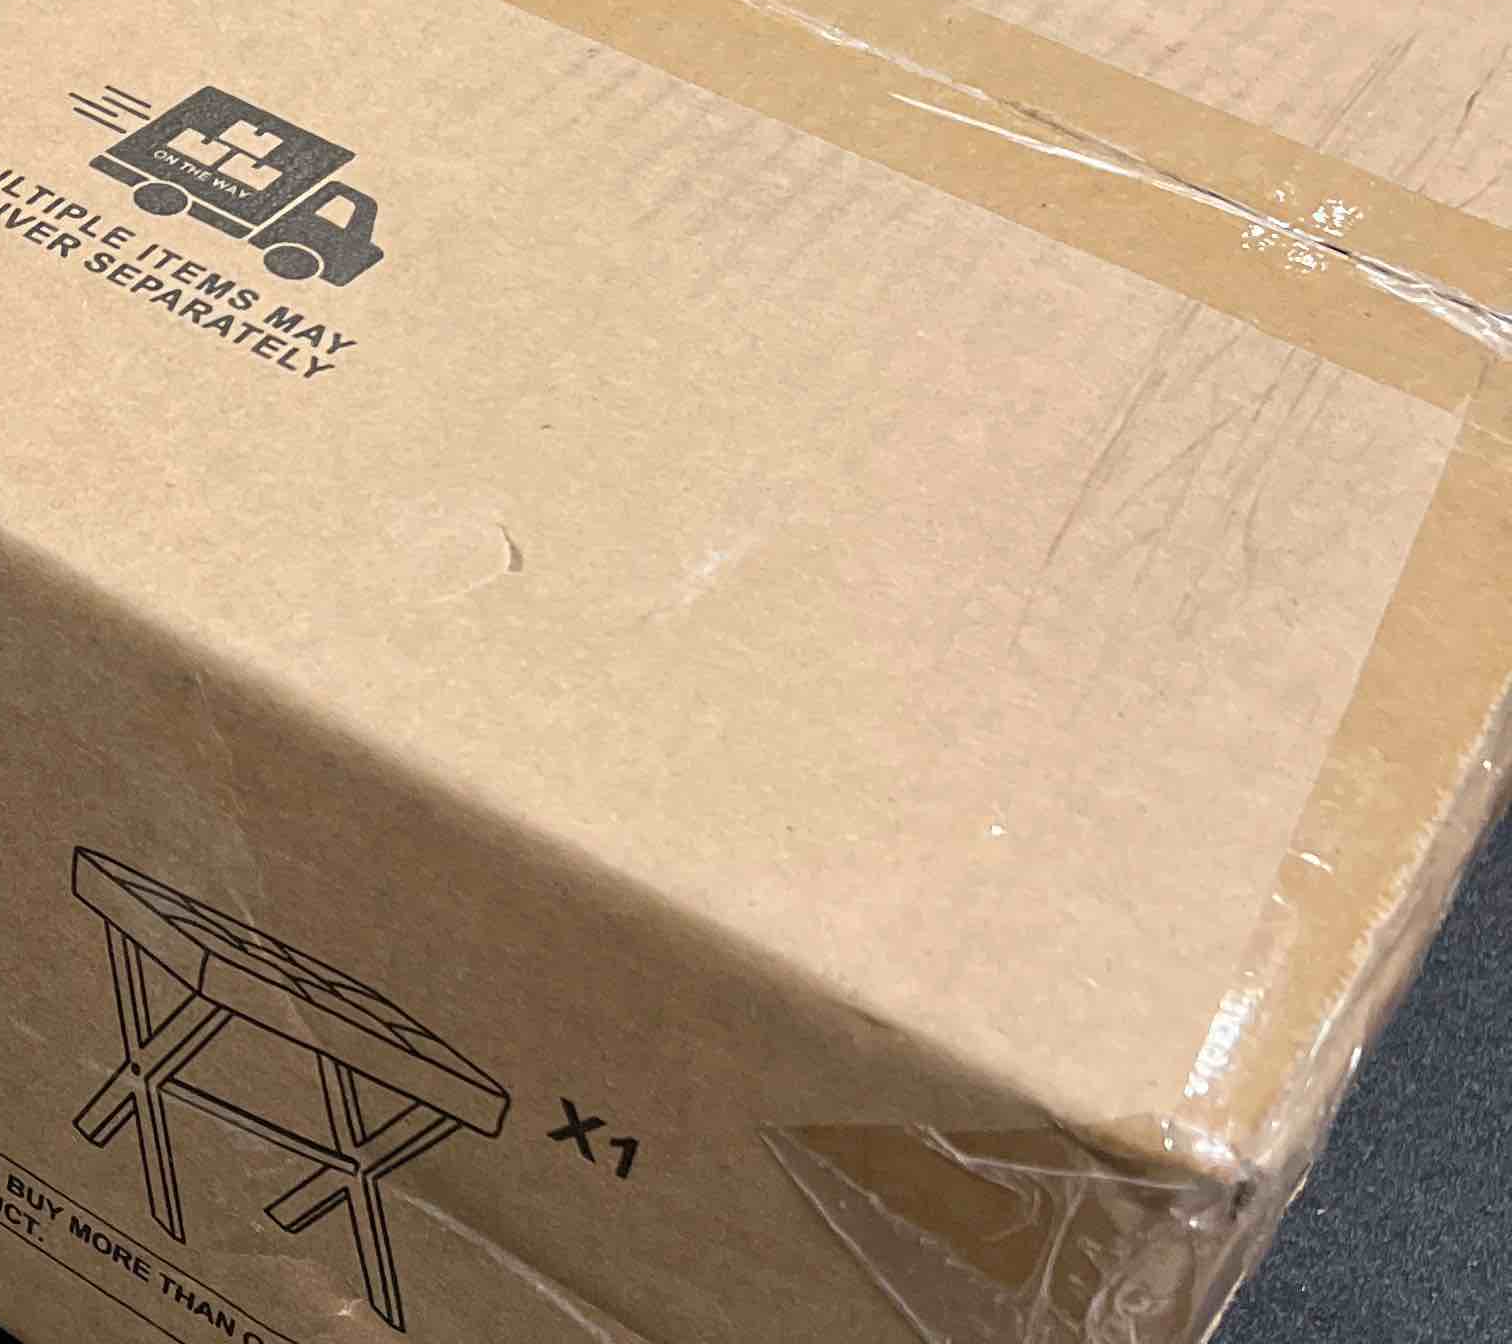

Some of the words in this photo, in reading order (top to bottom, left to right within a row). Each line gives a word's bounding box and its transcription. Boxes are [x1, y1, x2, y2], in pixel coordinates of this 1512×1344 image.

[153, 149, 180, 166] ON
[179, 161, 213, 182] THE
[212, 177, 251, 199] WAY
[85, 250, 336, 381] SEPARATELY
[136, 242, 261, 313] ITEMS
[264, 305, 358, 357] MAY
[546, 1096, 640, 1179] X1
[5, 1172, 65, 1222] BUY
[68, 1217, 152, 1285] MORE
[157, 1271, 238, 1338] THAN
